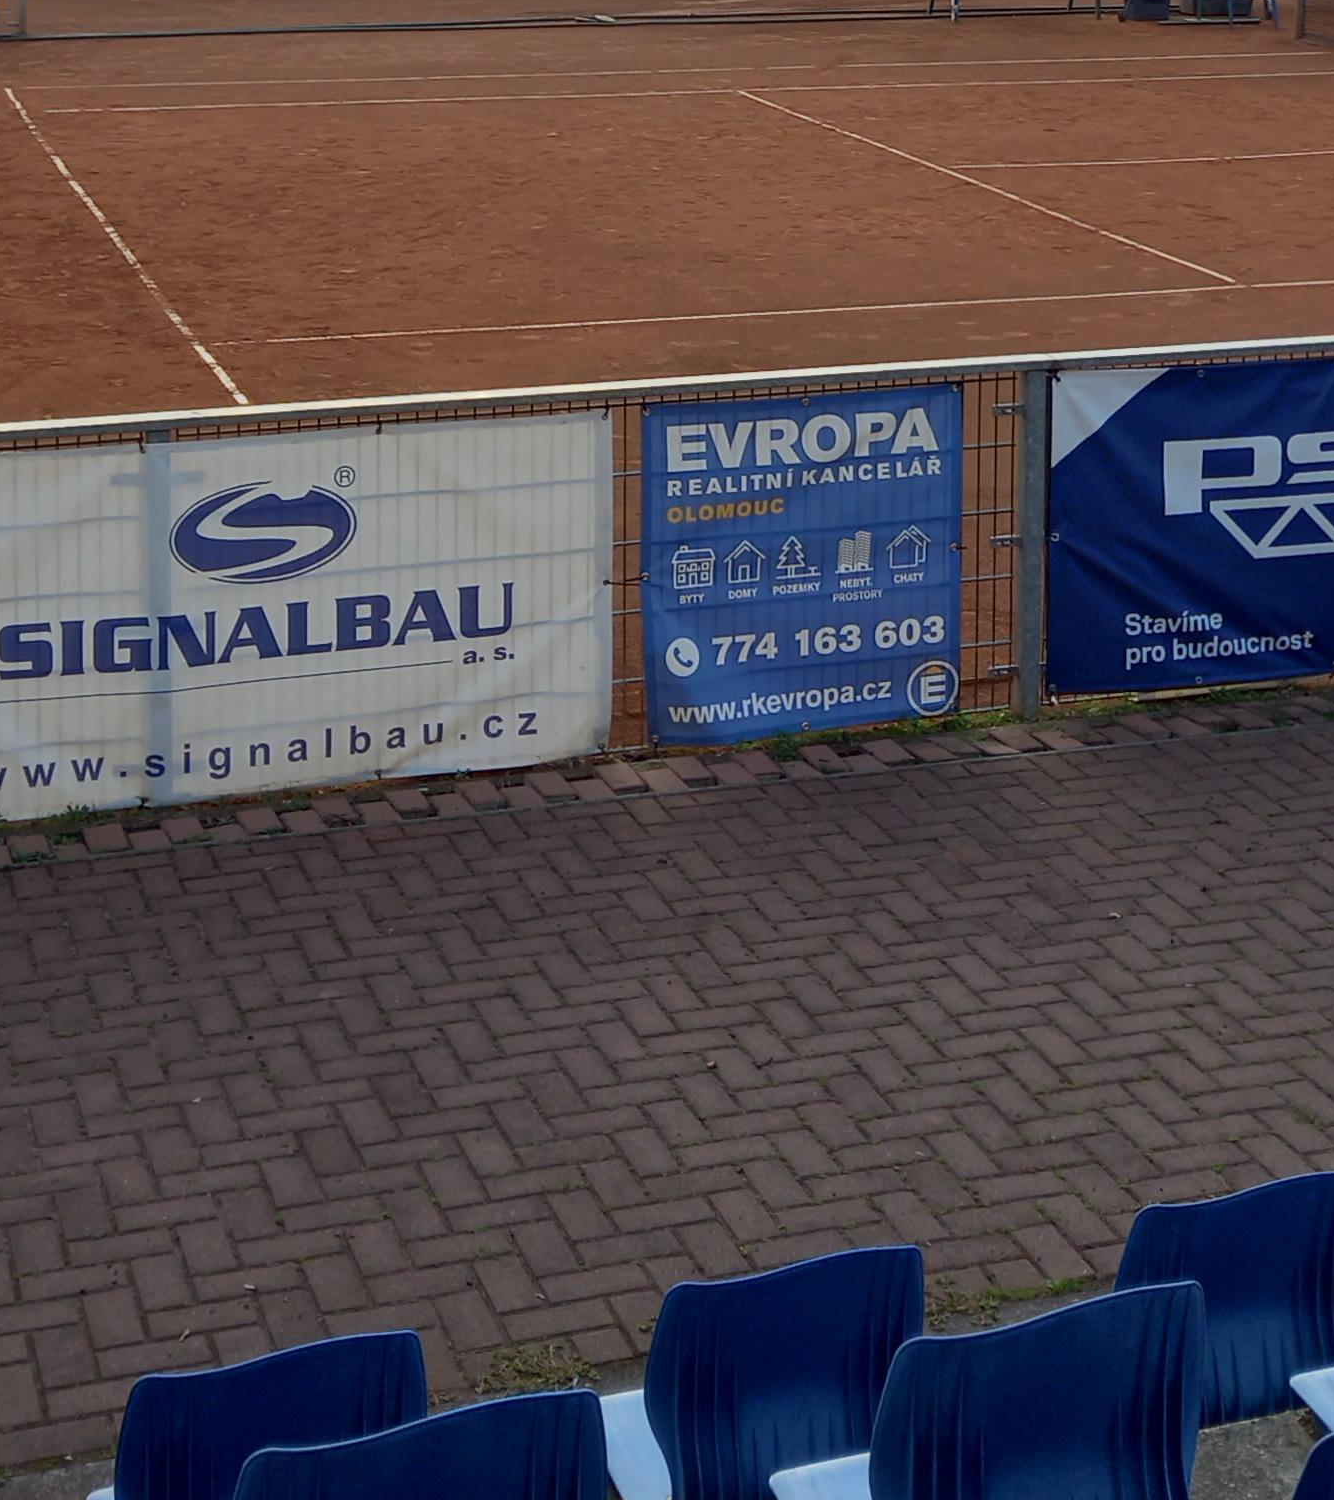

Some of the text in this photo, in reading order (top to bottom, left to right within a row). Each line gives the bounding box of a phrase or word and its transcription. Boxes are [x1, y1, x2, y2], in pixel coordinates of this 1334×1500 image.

[666, 407, 939, 473] EVROPA
[667, 454, 942, 498] REALITNÍ KANCELÁŘ
[666, 498, 785, 524] OLOMOUC
[772, 581, 821, 596] POZEMKY
[839, 576, 873, 589] NEBYT.
[893, 571, 925, 584] CHATY
[679, 592, 705, 605] BYTY
[728, 587, 758, 601] DOMY
[832, 589, 883, 603] PROSTORY
[1125, 609, 1223, 637] Stavíme
[711, 615, 946, 667] 774 163 603
[1125, 630, 1315, 670] pro budoucnost
[669, 680, 892, 725] www.rkevropa.cz
